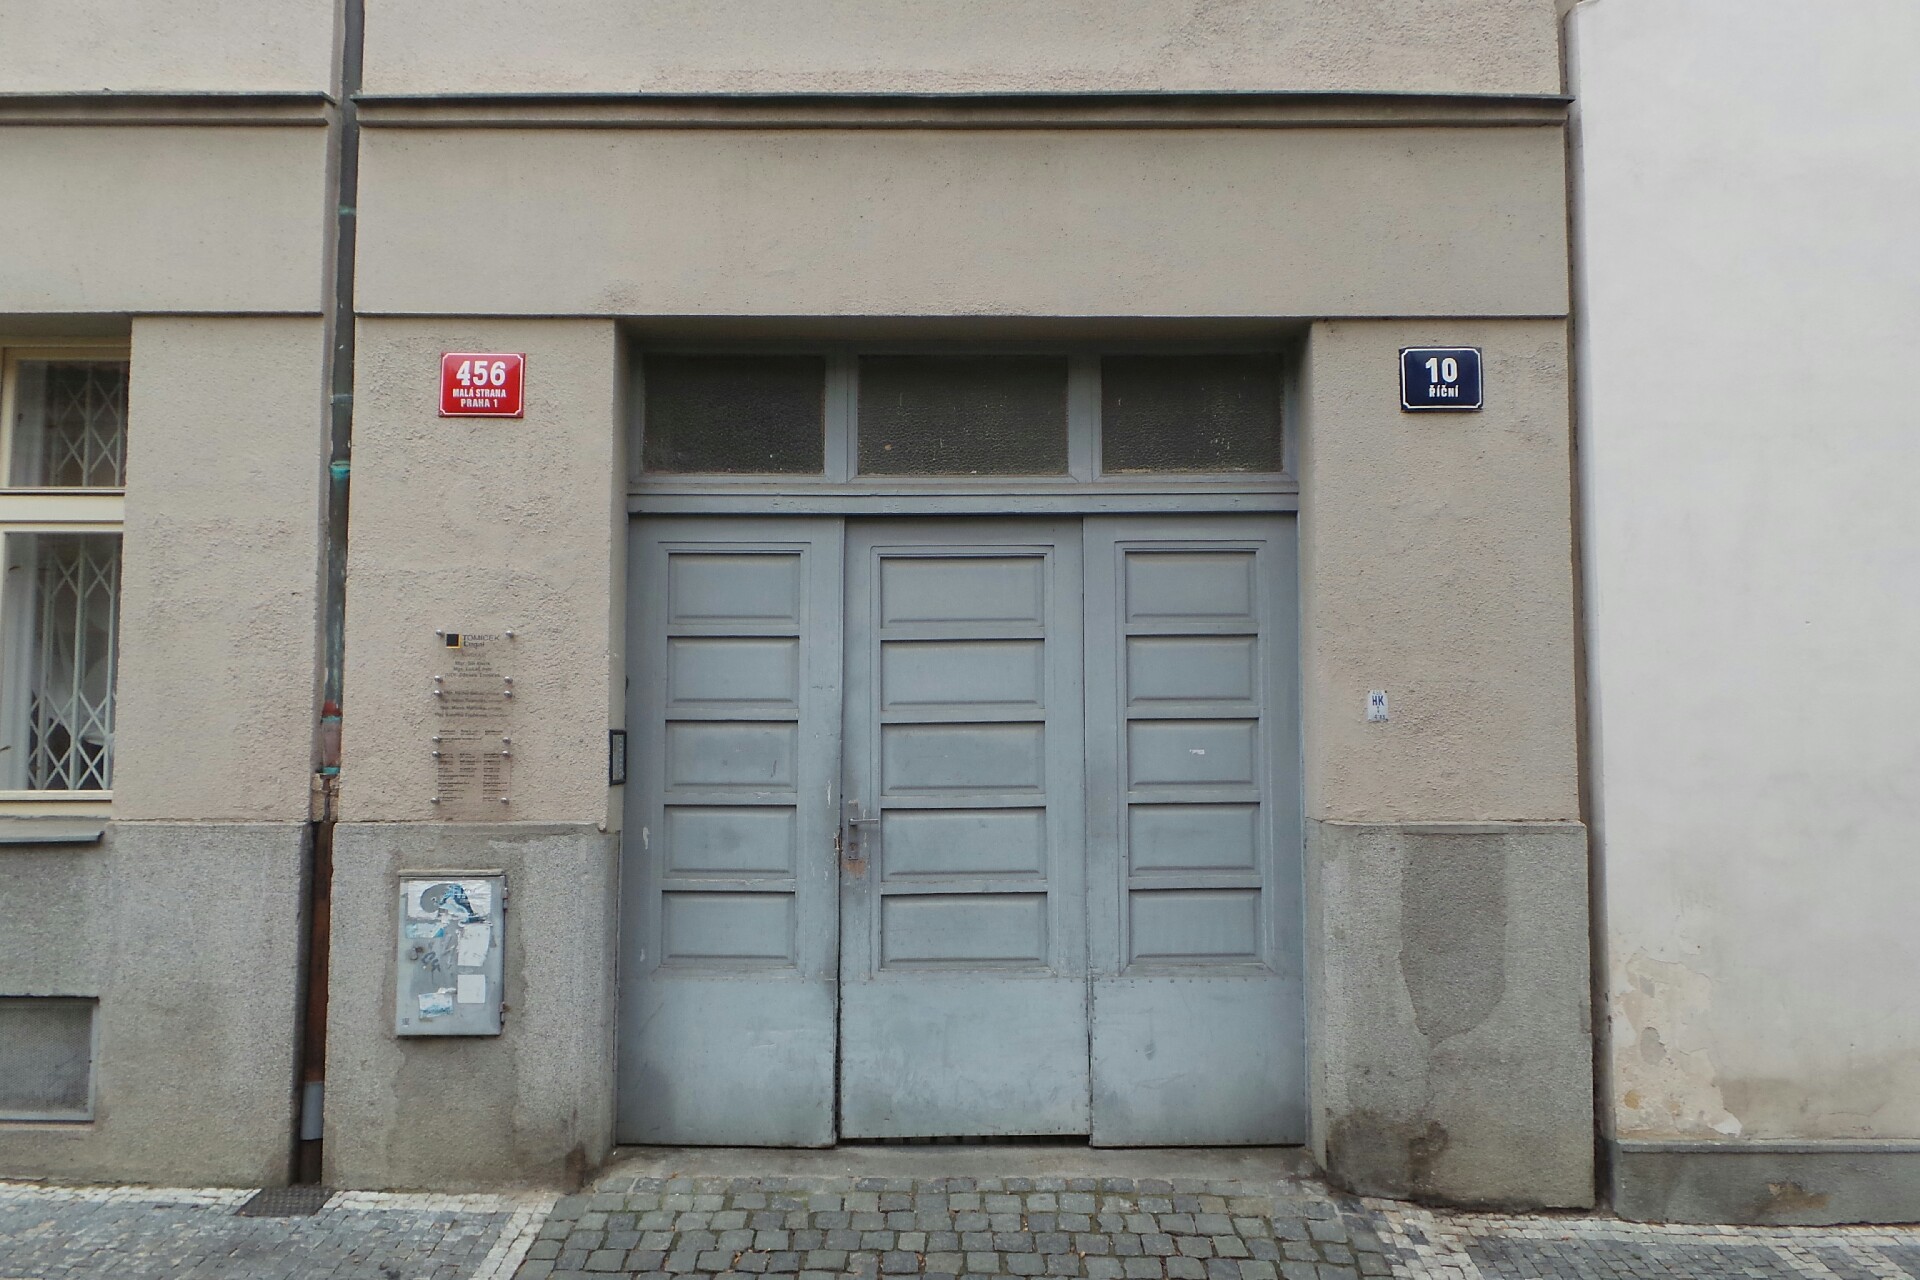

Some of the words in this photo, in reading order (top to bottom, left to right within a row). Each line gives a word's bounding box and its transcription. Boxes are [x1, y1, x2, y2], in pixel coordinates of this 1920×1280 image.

[456, 360, 506, 386] 456
[1425, 357, 1458, 383] 10
[452, 387, 474, 398] MALÁ
[475, 388, 507, 398] STRANA
[1428, 384, 1459, 398] ŘÍČNÍ
[460, 398, 490, 408] PRAHA
[493, 398, 498, 408] 1
[1371, 695, 1384, 706] HK
